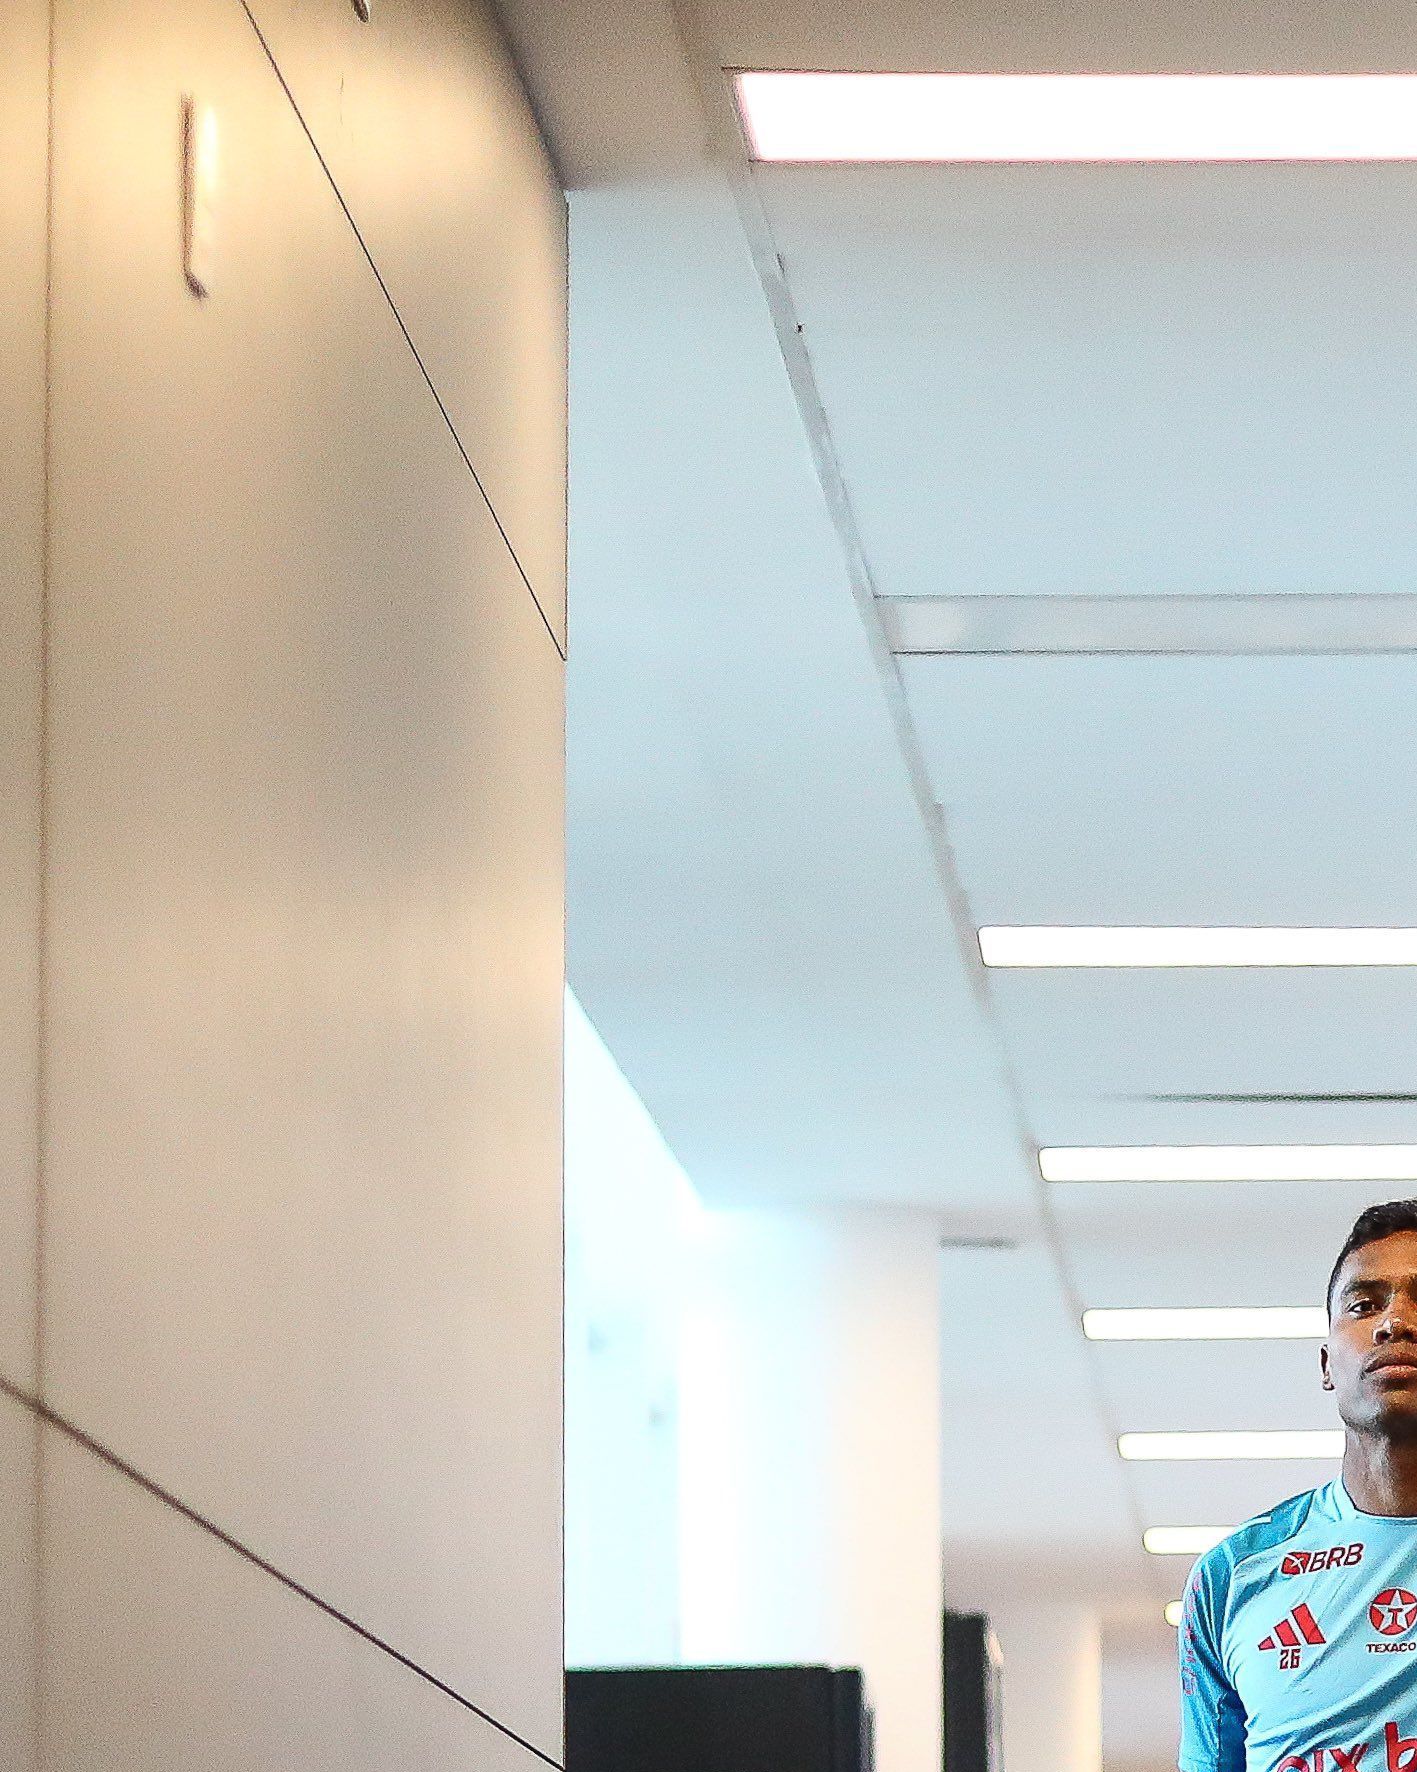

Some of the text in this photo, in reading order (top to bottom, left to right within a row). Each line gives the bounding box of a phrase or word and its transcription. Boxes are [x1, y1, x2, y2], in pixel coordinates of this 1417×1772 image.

[1308, 1542, 1365, 1573] BRB
[1279, 1648, 1301, 1670] 26
[1366, 1642, 1417, 1655] TEXACO
